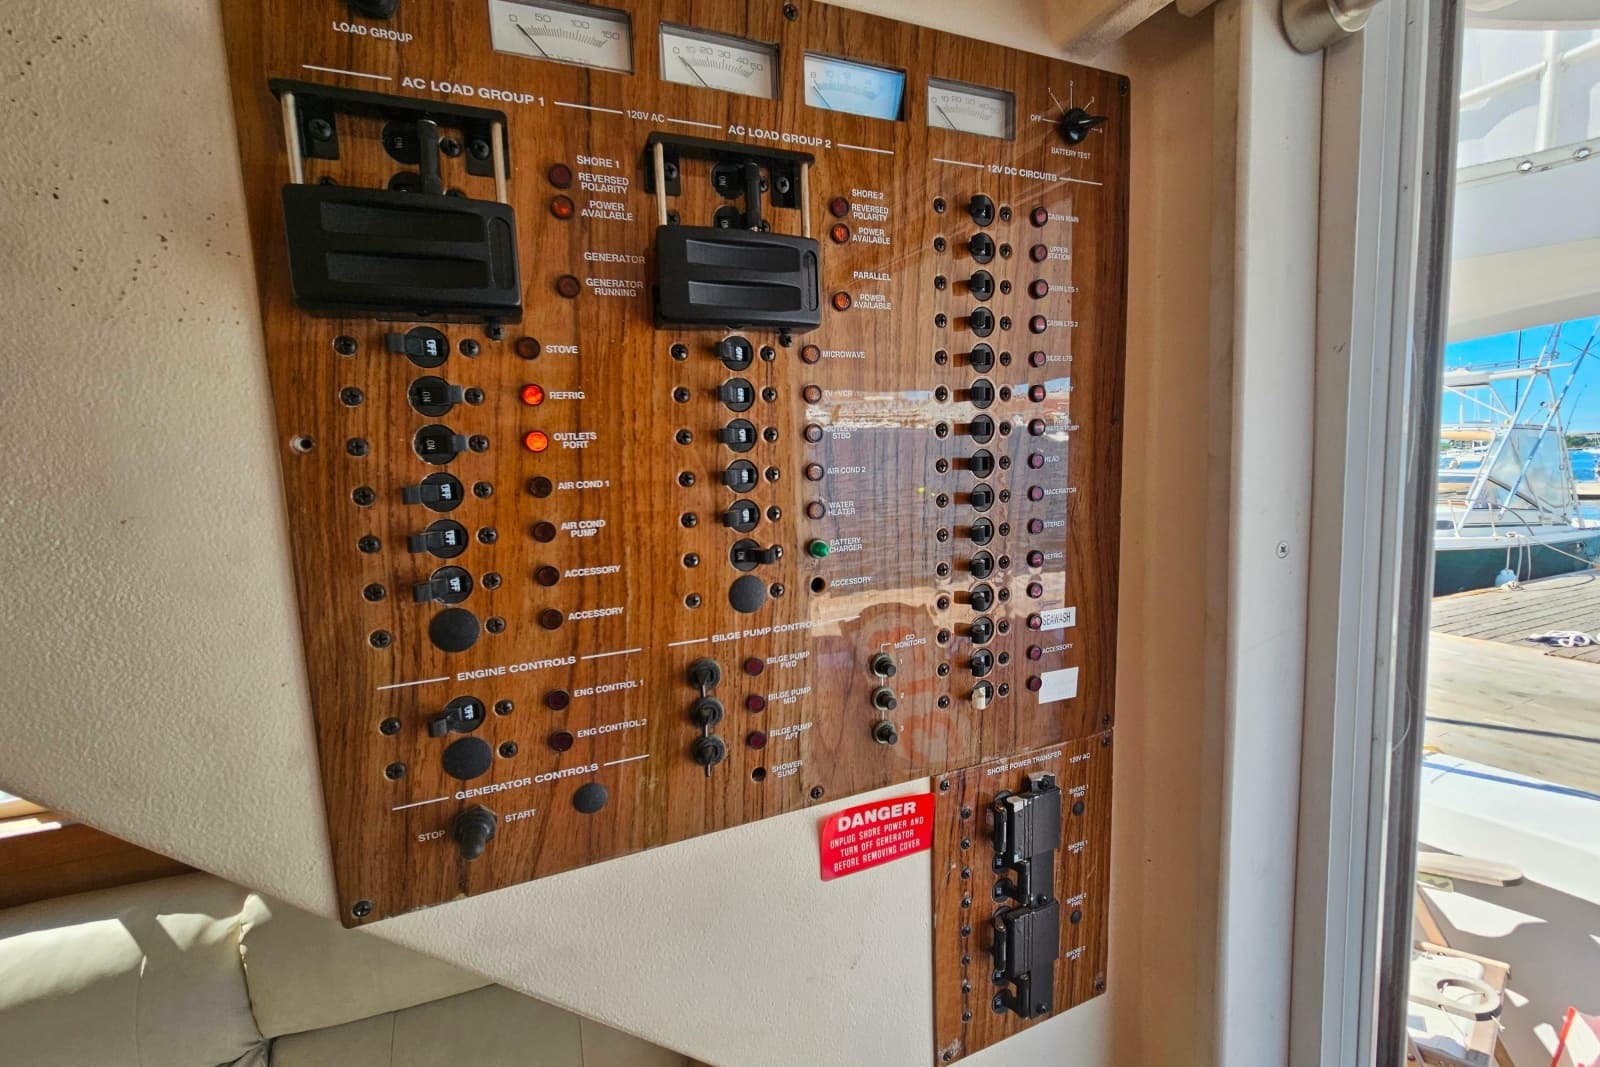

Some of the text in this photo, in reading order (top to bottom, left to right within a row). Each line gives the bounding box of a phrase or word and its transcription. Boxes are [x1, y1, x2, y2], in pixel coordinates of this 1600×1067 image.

[332, 21, 413, 42] LOAD GROUP
[402, 76, 545, 107] AC LOAD GROUP 1
[626, 110, 665, 124] 120V AC
[728, 125, 832, 148] AC LOAD GROUP 2
[1050, 146, 1091, 160] BATTERY TEST
[576, 155, 620, 169] SHORE 1
[988, 164, 1002, 174] 12V
[1004, 166, 1017, 176] DC
[578, 172, 629, 186] REVERSED
[581, 182, 628, 194] POLARITY
[852, 188, 876, 200] SHORE
[589, 200, 625, 212] POWER
[852, 204, 889, 215] REVERSED
[581, 209, 633, 222] AVAILABLE
[853, 211, 888, 222] POLARITY
[858, 227, 884, 237] POWER
[852, 234, 891, 246] AVAILABLE
[584, 252, 646, 264] GENERATOR
[854, 271, 892, 281] PARALLEL
[586, 278, 644, 290] GENERATOR
[594, 287, 637, 298] RUNNING
[860, 294, 886, 303] POWER
[854, 301, 892, 310] AVAILABLE
[426, 339, 438, 356] OFF
[546, 344, 579, 354] STOVE
[822, 350, 866, 359] MICROWAVE
[549, 391, 586, 400] REFRIG
[553, 432, 597, 442] OUTLETS
[562, 440, 589, 450] PORT
[827, 466, 840, 474] AIR
[558, 480, 610, 490] AIR COND 1
[440, 484, 452, 500] OFF
[829, 500, 854, 509] WATER
[742, 509, 750, 522] OFF
[828, 508, 856, 516] HEATER
[561, 520, 606, 531] AIR COND
[444, 530, 456, 546] OFF
[570, 528, 598, 538] PUMP
[830, 537, 861, 546] BATTERY
[830, 544, 863, 554] CHARGER
[564, 565, 621, 578] ACCESSORY
[449, 576, 460, 592] OFF
[830, 576, 872, 588] ACCESSORY
[568, 607, 624, 621] ACCESSORY
[1042, 611, 1071, 626] SEAWASH
[712, 626, 771, 643] BILGE PUMP
[894, 637, 927, 649] MONITORS
[1042, 643, 1073, 654] ACCESSORY
[767, 651, 810, 664] BILGE PUMP
[457, 656, 576, 681] ENGINE CONTROLS
[780, 660, 797, 668] FWD
[574, 688, 594, 698] ENG
[595, 681, 638, 694] CONTROL
[768, 686, 812, 702] BILGE PUMP
[783, 696, 798, 705] MID
[464, 704, 474, 720] OFF
[577, 718, 648, 738] ENG CONTROL 2
[770, 722, 813, 738] BILGE PUMP
[784, 732, 799, 741] AFT
[772, 760, 804, 774] SHOWER
[987, 751, 1062, 776] SHORE POWER TRANSFER
[777, 768, 799, 778] SUMP
[455, 763, 599, 800] GENERATOR CONTROLS
[505, 808, 536, 822] START
[838, 802, 917, 832] DANGER
[418, 830, 445, 842] STOP
[830, 816, 924, 849] UNPLUG SHORE POWER AND
[840, 829, 914, 857] TURN OFF GENERATOR
[834, 838, 920, 872] BEFORE REMOVING COVER
